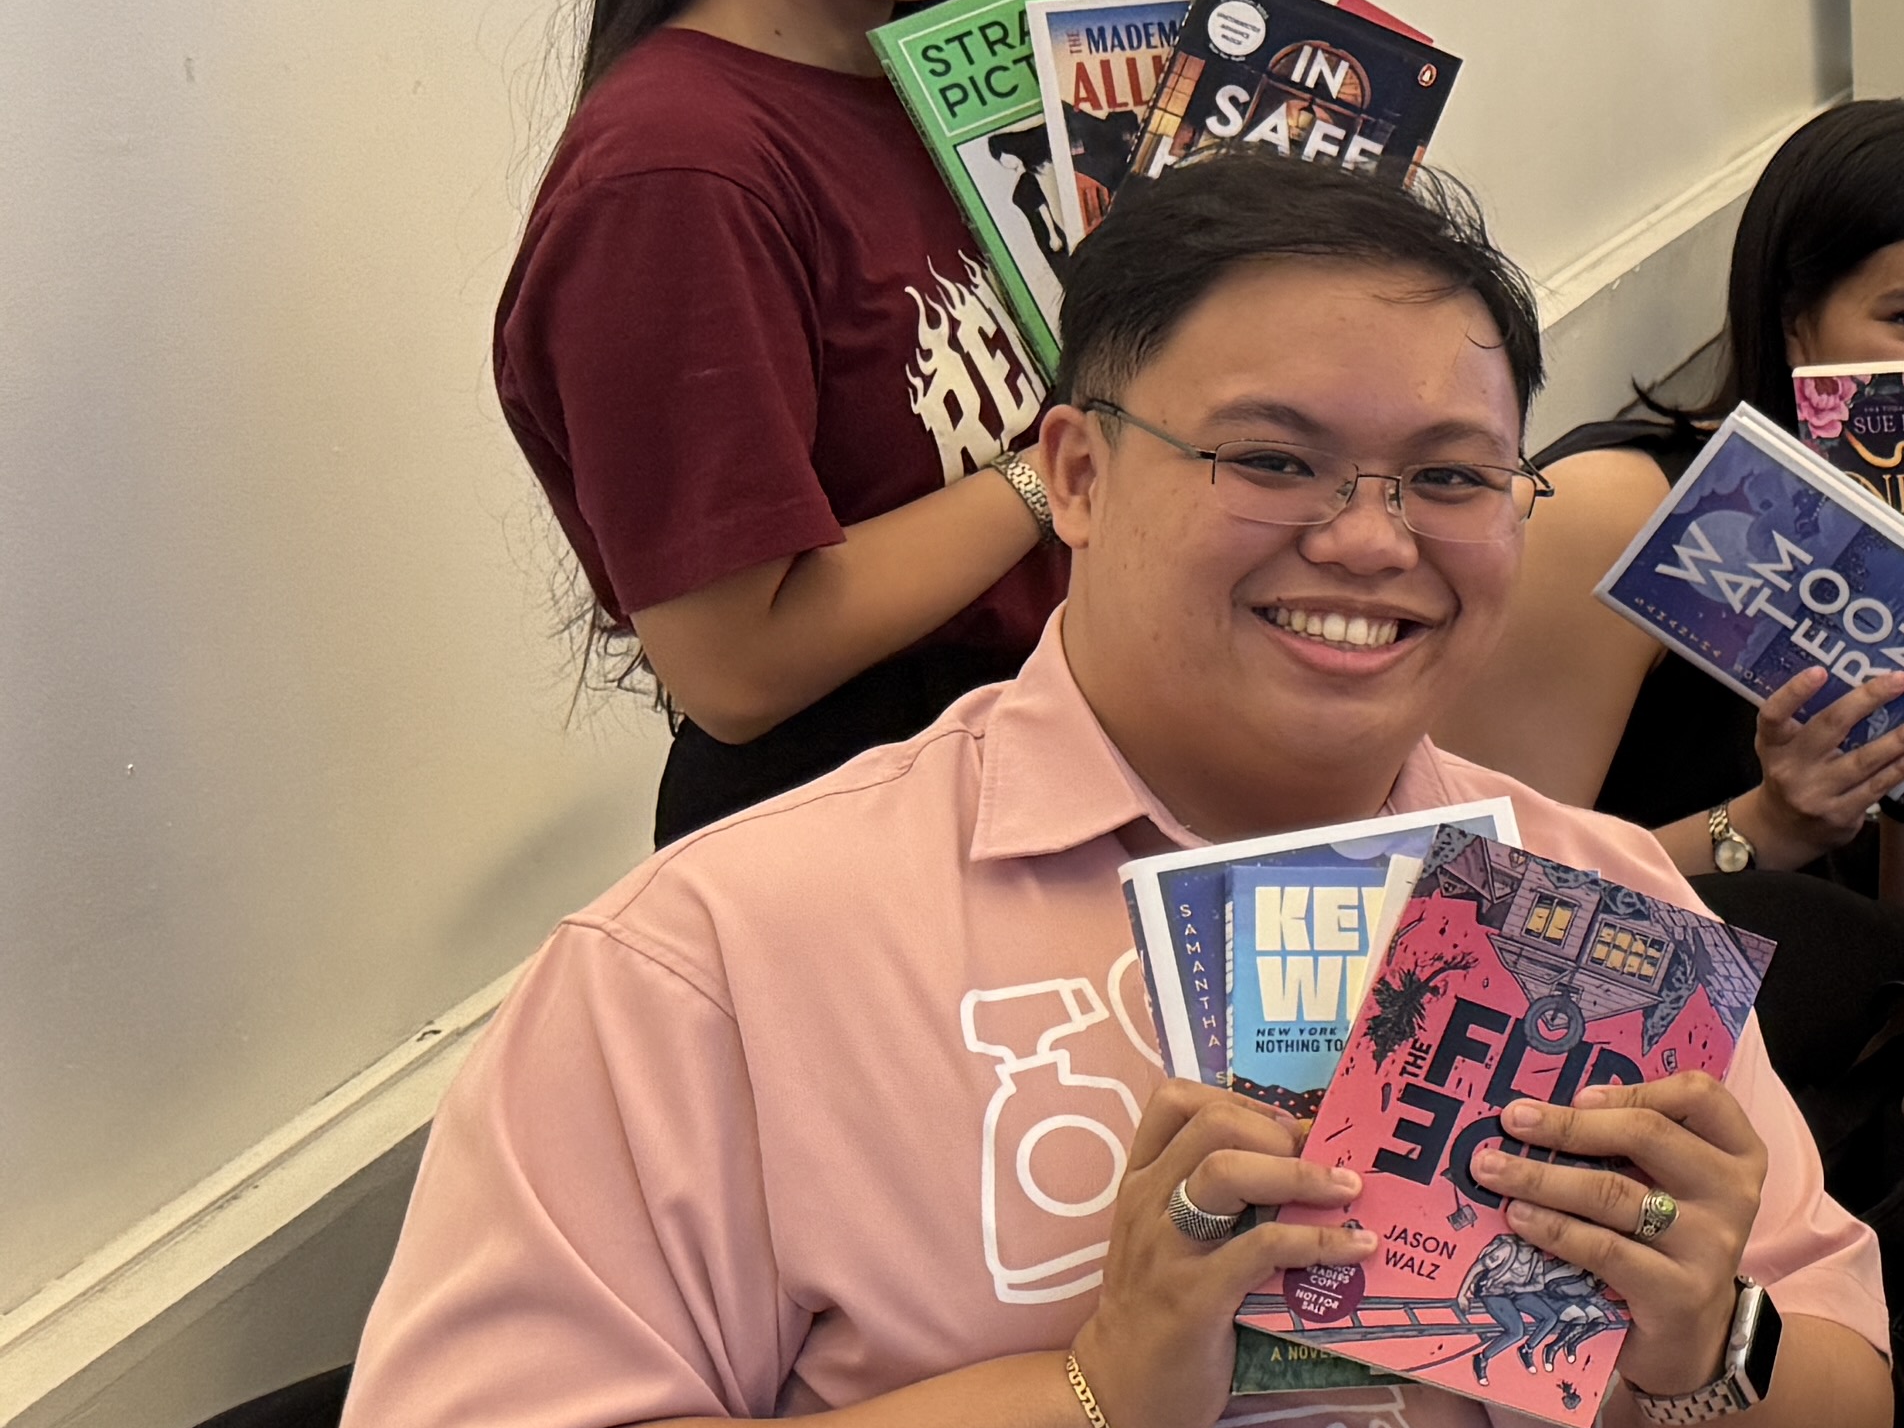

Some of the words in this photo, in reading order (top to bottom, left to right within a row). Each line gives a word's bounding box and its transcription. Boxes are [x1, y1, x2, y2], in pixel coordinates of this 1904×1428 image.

[1067, 28, 1083, 54] THE
[1291, 44, 1349, 100] IN
[1853, 413, 1897, 435] SUE
[1179, 903, 1221, 1048] SAMANTHA
[1256, 1027, 1291, 1037] NEW
[1299, 1027, 1337, 1036] YORK
[1256, 1040, 1321, 1053] NOTHING
[1399, 1036, 1432, 1079] THE
[1384, 1225, 1457, 1260] JASON
[1385, 1248, 1441, 1281] WALZ
[1296, 1288, 1318, 1302] NOT
[1270, 1346, 1282, 1362] A
